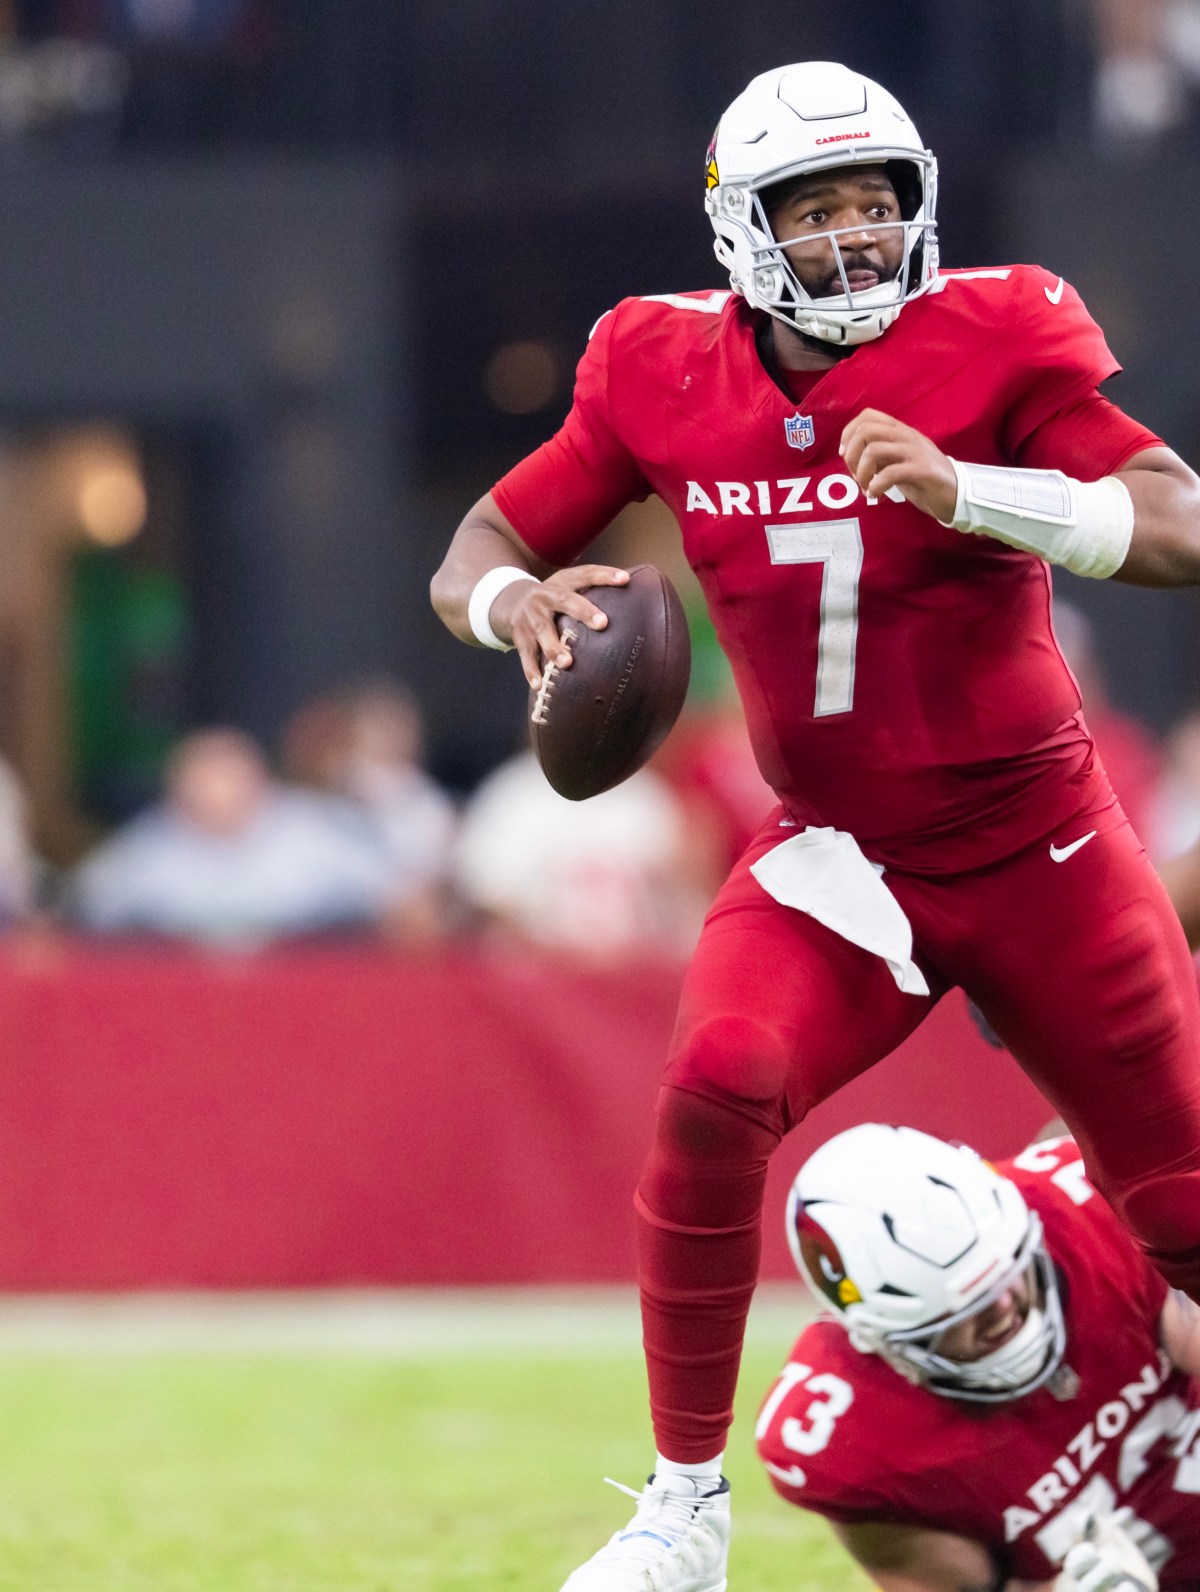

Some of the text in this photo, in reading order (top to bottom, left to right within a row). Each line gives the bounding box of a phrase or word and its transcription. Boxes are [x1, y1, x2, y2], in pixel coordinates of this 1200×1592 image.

[815, 131, 871, 145] CARDINALS
[790, 429, 811, 444] NFL
[764, 518, 864, 718] 7
[626, 634, 645, 674] LEAGUE
[755, 1362, 854, 1456] 73
